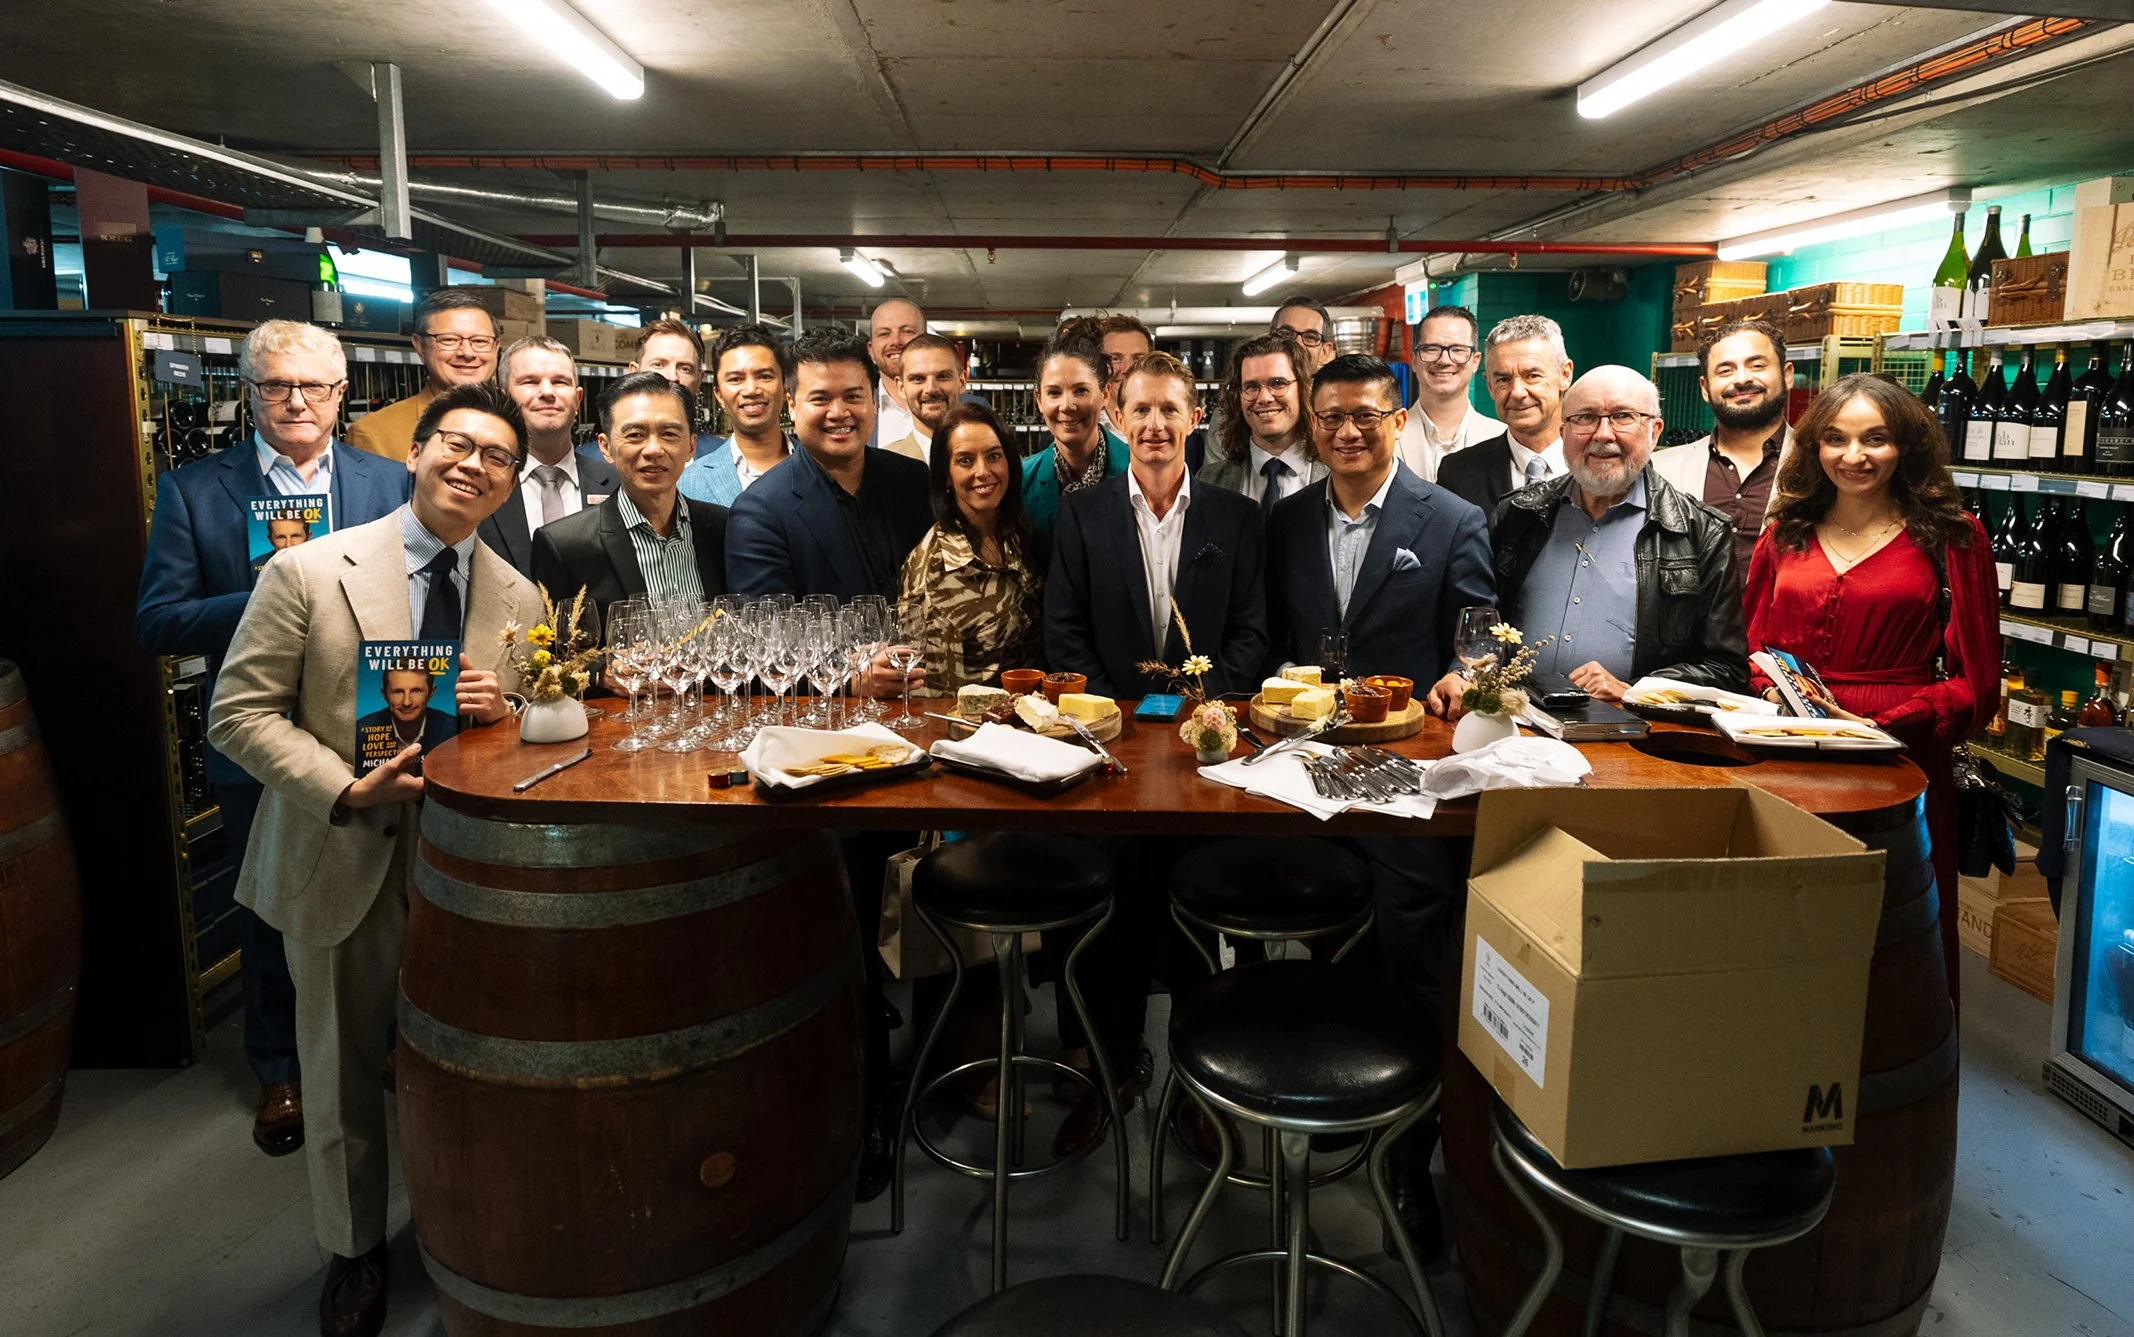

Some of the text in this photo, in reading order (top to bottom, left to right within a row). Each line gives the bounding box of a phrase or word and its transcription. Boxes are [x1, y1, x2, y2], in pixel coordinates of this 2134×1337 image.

[250, 498, 323, 511] EVERYTHING
[255, 508, 322, 521] WILL BE OK
[365, 645, 453, 658] EVERYTHING
[369, 657, 450, 672] WILL BE OK
[365, 725, 385, 733] STORY
[363, 741, 384, 751] LOVE
[1803, 1082, 1843, 1123] M
